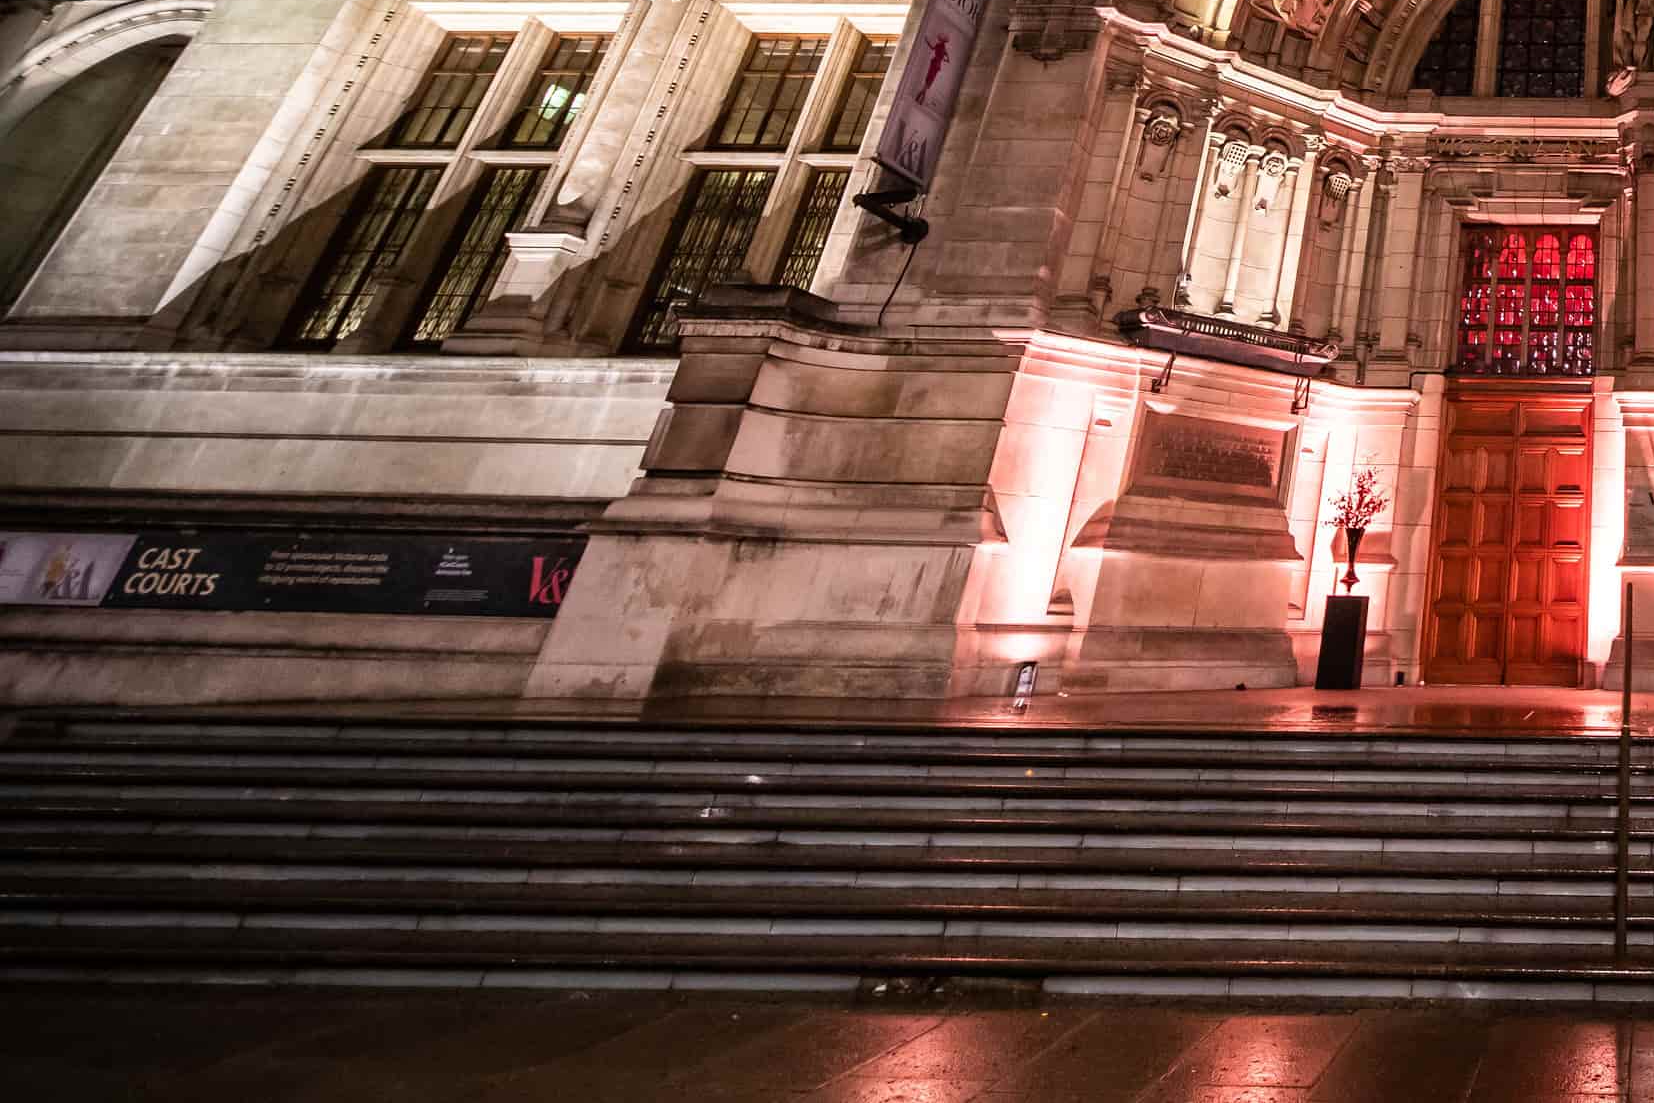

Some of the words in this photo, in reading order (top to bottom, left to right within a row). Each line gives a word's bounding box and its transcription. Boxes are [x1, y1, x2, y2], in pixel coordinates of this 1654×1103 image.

[138, 547, 202, 570] CAST
[123, 572, 220, 596] COURTS
[528, 556, 577, 605] V&
